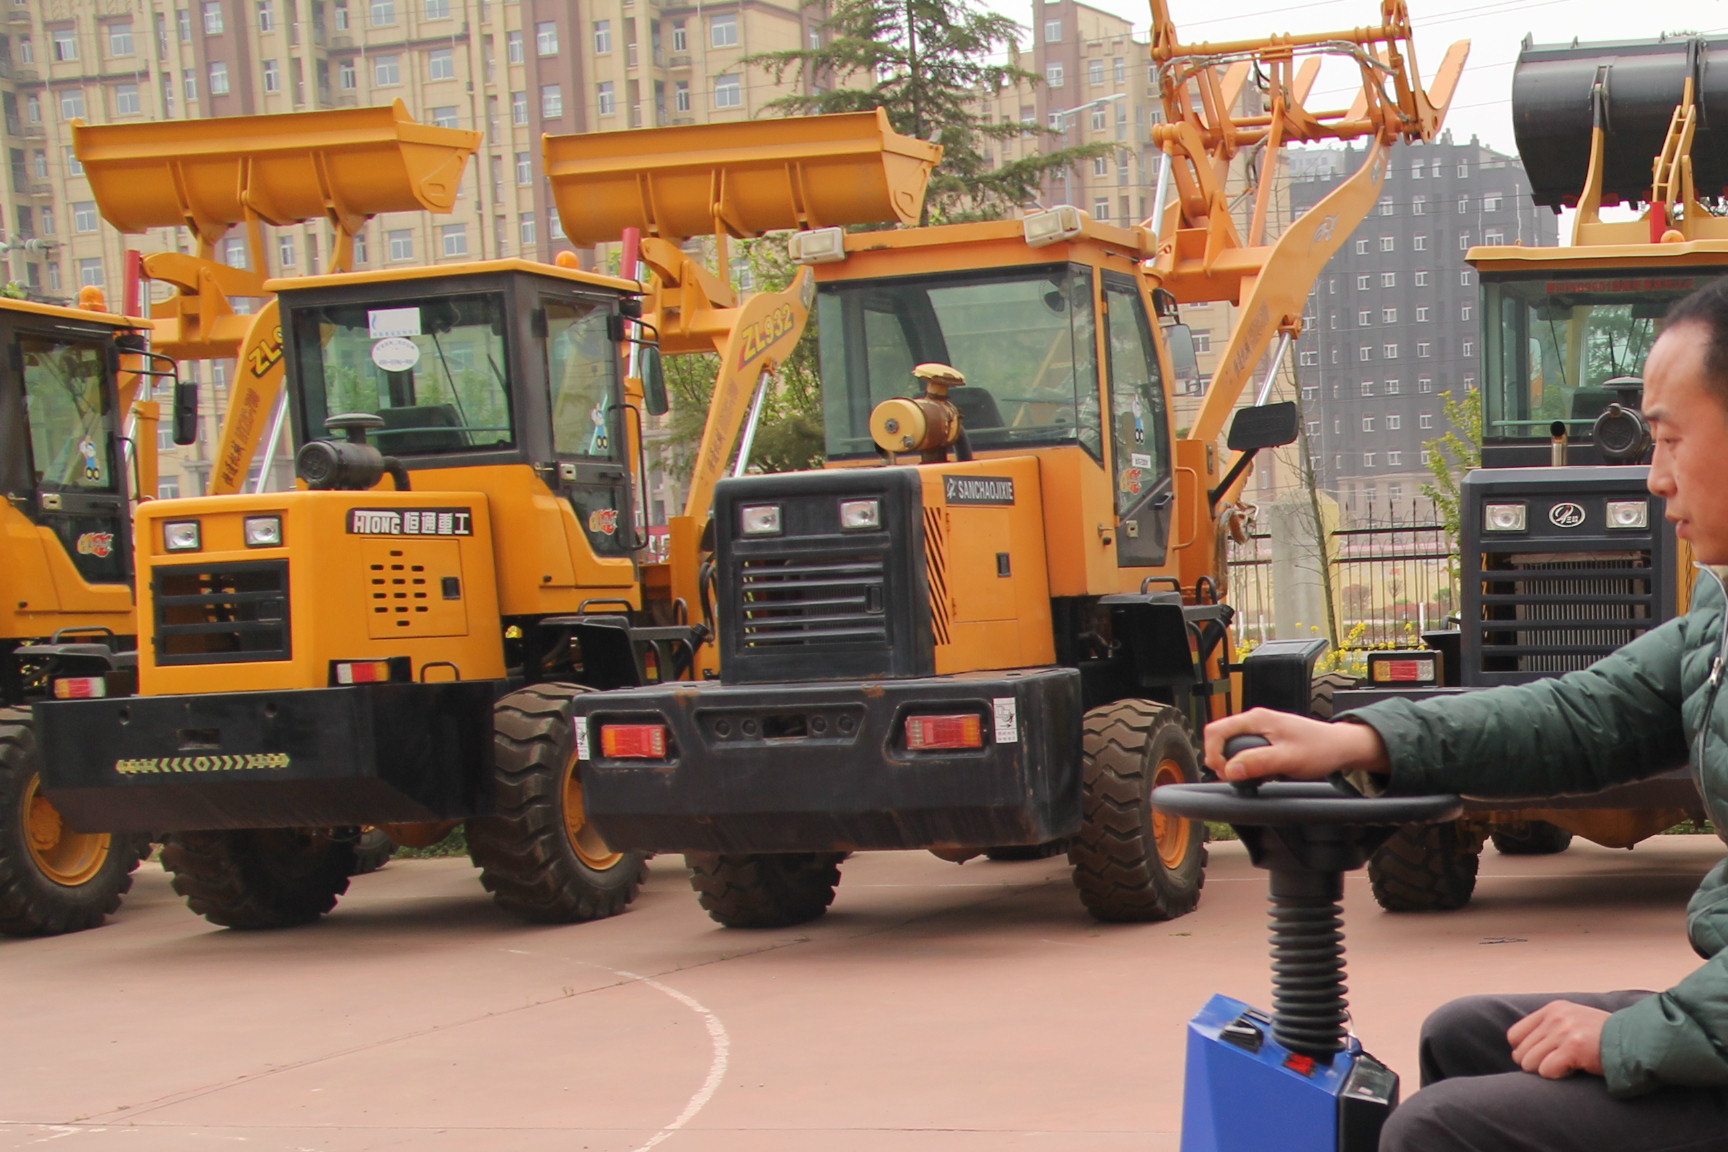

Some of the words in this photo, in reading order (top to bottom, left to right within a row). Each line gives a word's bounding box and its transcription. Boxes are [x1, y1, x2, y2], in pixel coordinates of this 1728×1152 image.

[741, 302, 794, 365] ZL932
[958, 480, 1014, 500] SANCHAOJIXIE
[403, 511, 470, 535] 恒通重工
